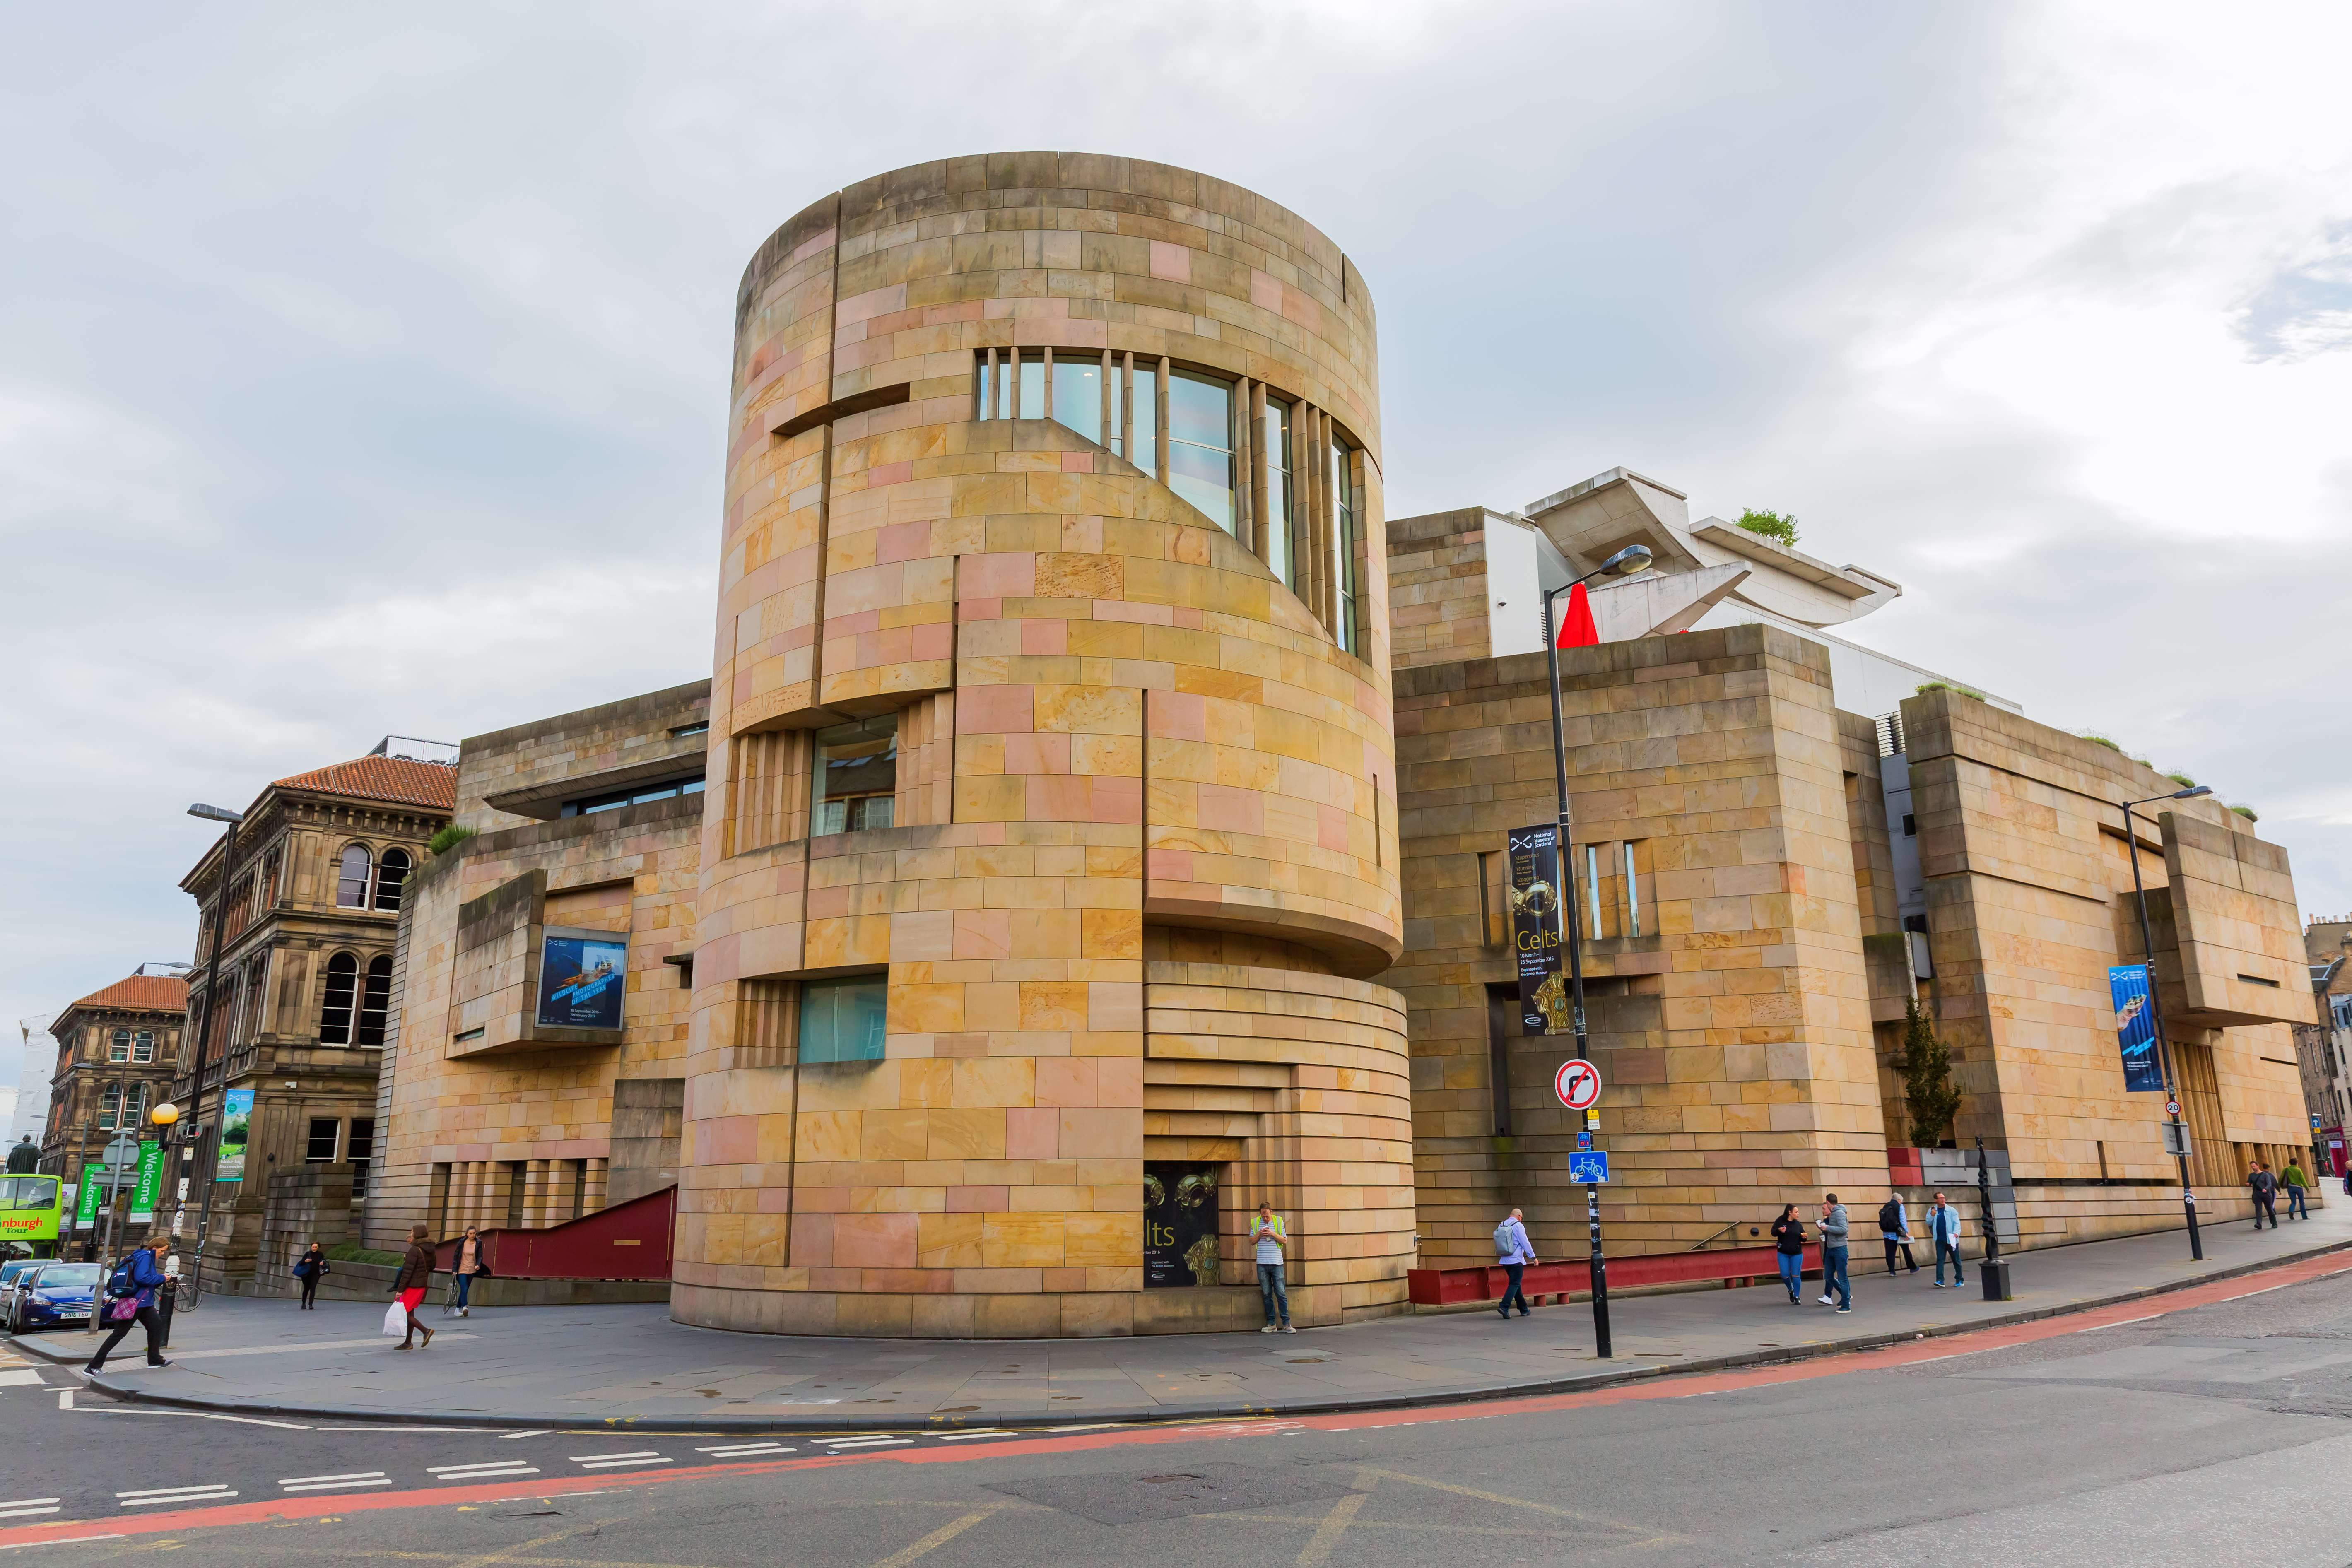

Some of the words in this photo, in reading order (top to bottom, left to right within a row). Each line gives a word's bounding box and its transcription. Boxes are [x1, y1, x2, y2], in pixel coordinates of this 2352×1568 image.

[1517, 928, 1558, 951] Celts
[551, 983, 578, 1000] WILDLIFE
[573, 973, 615, 997] PHOTOGRAPHER
[581, 992, 591, 1001] THE
[593, 985, 607, 995] YEAR
[140, 1152, 158, 1204] Welcome
